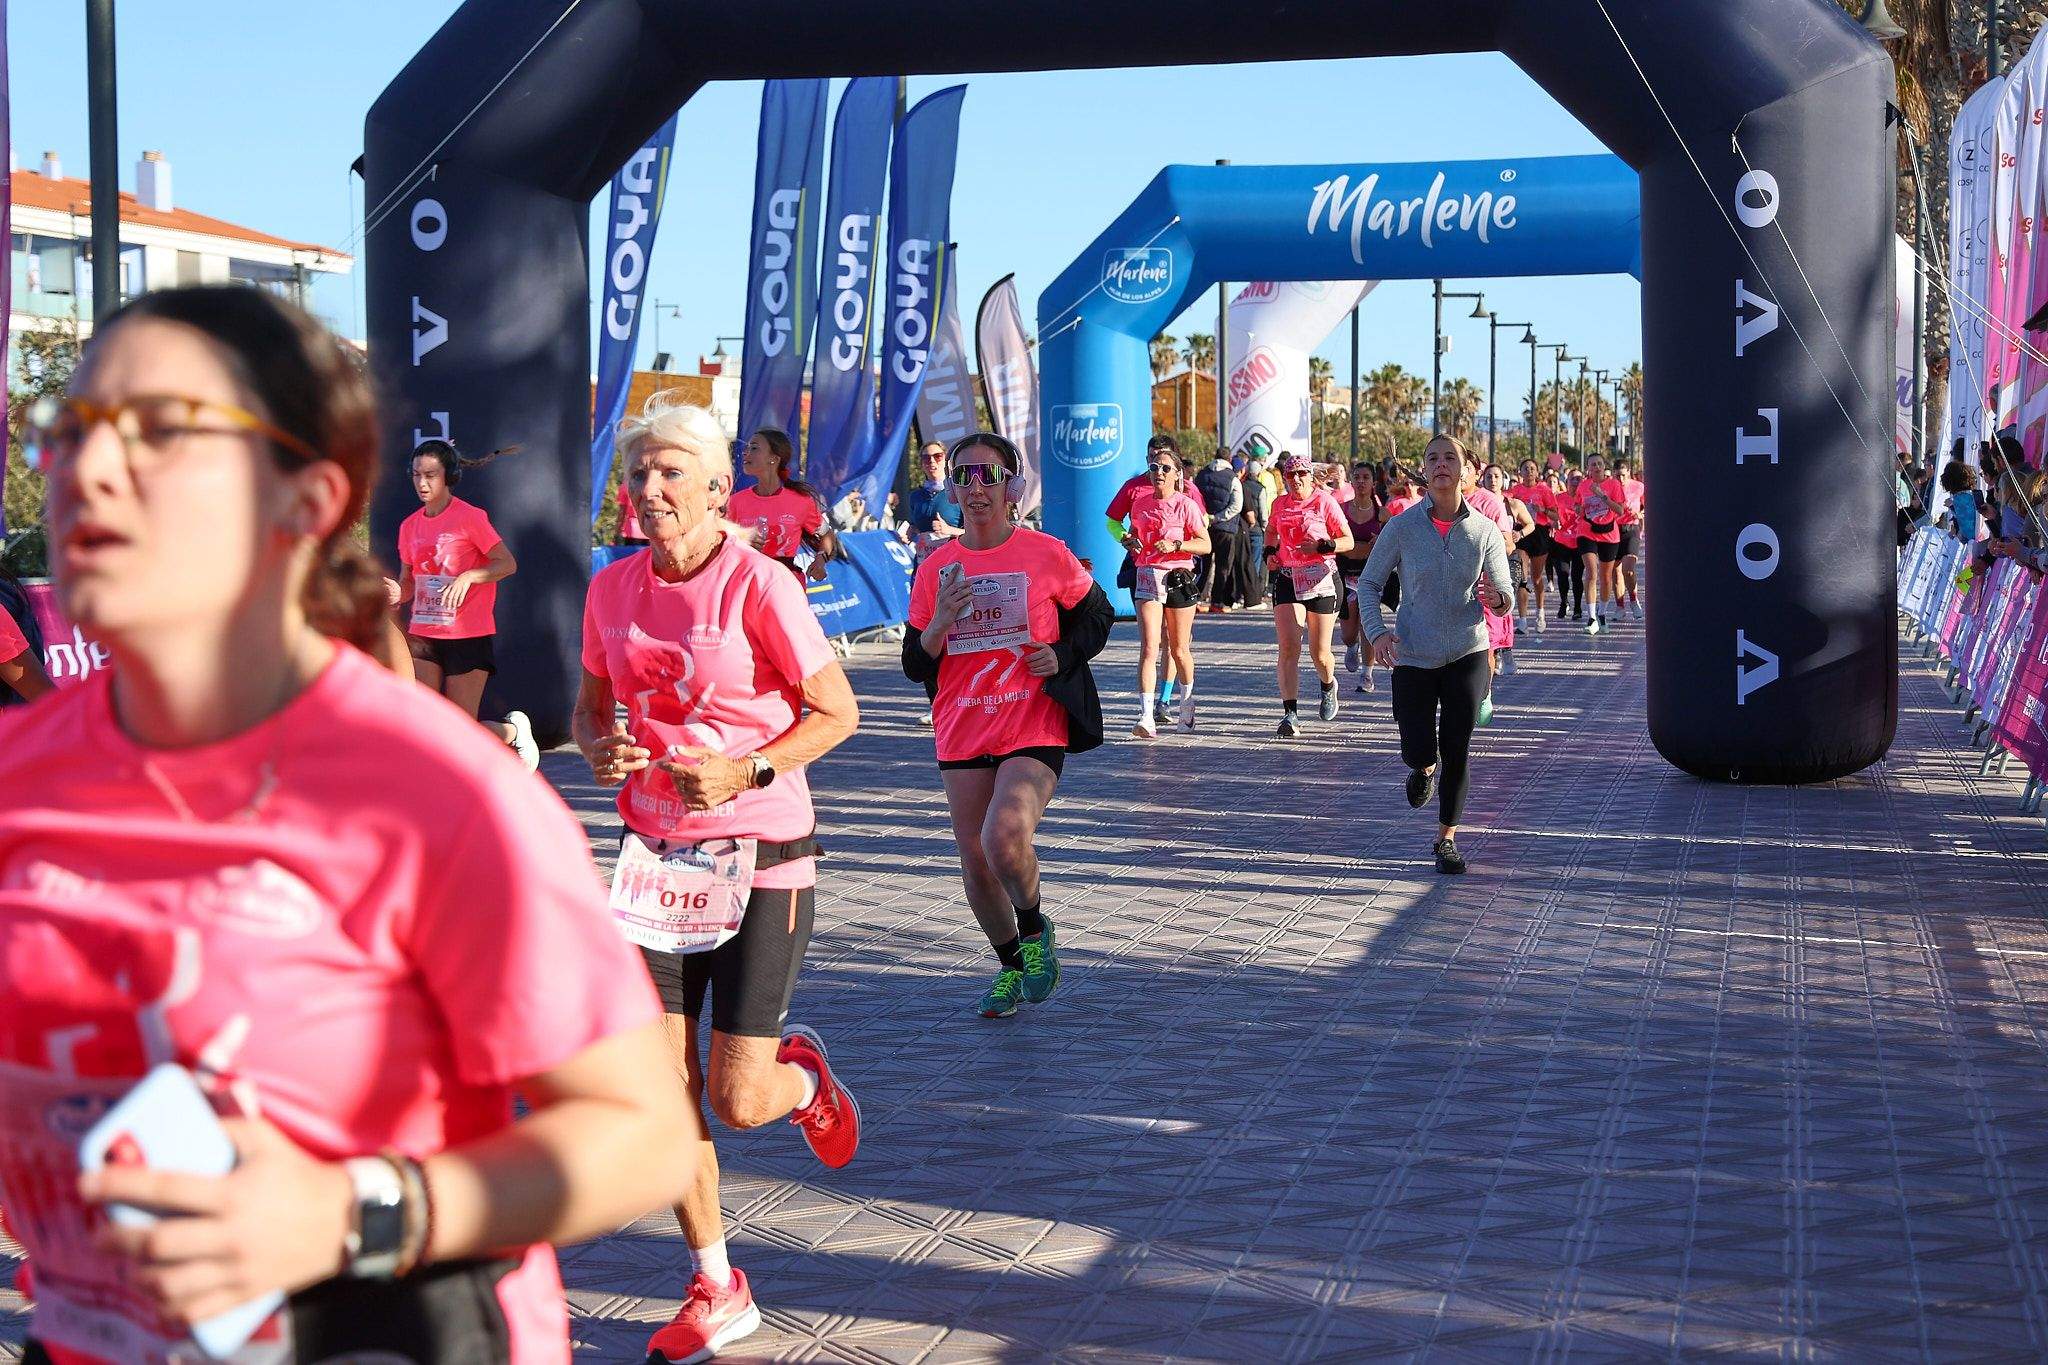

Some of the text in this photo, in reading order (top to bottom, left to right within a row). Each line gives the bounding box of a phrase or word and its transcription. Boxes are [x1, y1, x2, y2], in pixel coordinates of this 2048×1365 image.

[1307, 171, 1518, 265] Marlene
[607, 147, 658, 341] GOYA
[1106, 260, 1168, 289] Marlene
[831, 214, 872, 372] GOYA
[893, 239, 931, 385] GOYA
[1055, 418, 1118, 452] Marlene
[1735, 169, 1780, 706] VOLVO
[973, 606, 1003, 621] 016
[956, 640, 983, 650] OYSHO
[983, 695, 993, 705] DE
[994, 694, 1003, 705] LA
[661, 800, 673, 817] DE
[669, 856, 711, 868] ASTURIANA
[660, 890, 709, 909] 016
[665, 913, 690, 922] 2222
